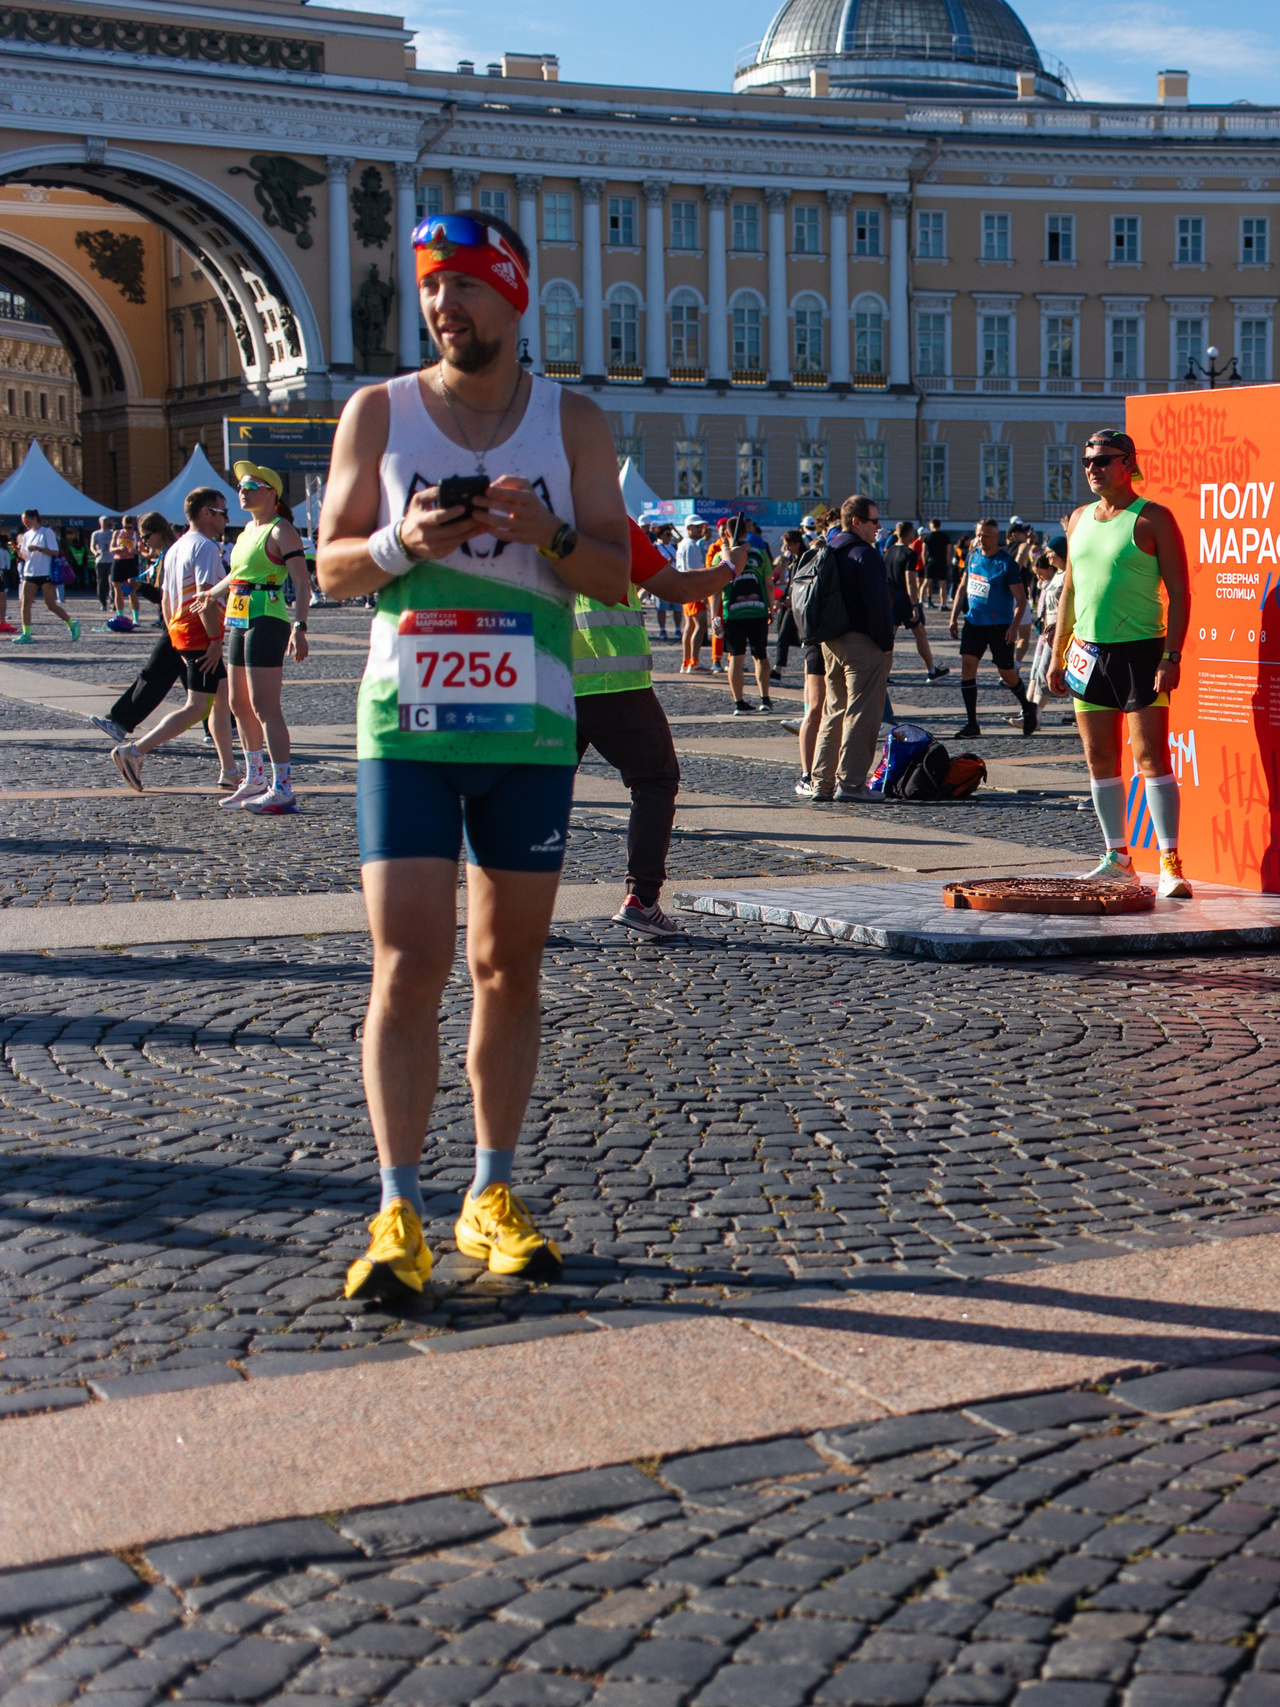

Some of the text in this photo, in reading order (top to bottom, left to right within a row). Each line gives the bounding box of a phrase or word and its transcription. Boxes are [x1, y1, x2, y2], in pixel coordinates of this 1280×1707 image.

[491, 264, 518, 290] adidas
[1200, 482, 1275, 519] ПОЛУ
[69, 519, 84, 527] Exit
[1216, 573, 1260, 584] СЕВЕРНАЯ
[1216, 588, 1257, 600] СТОЛИЦА
[415, 612, 438, 620] ПОЛУ
[415, 619, 458, 627] МАРАФОН
[476, 617, 496, 628] 21,1
[1199, 628, 1217, 641] 09
[1248, 630, 1267, 643] 08
[415, 651, 518, 689] 7256
